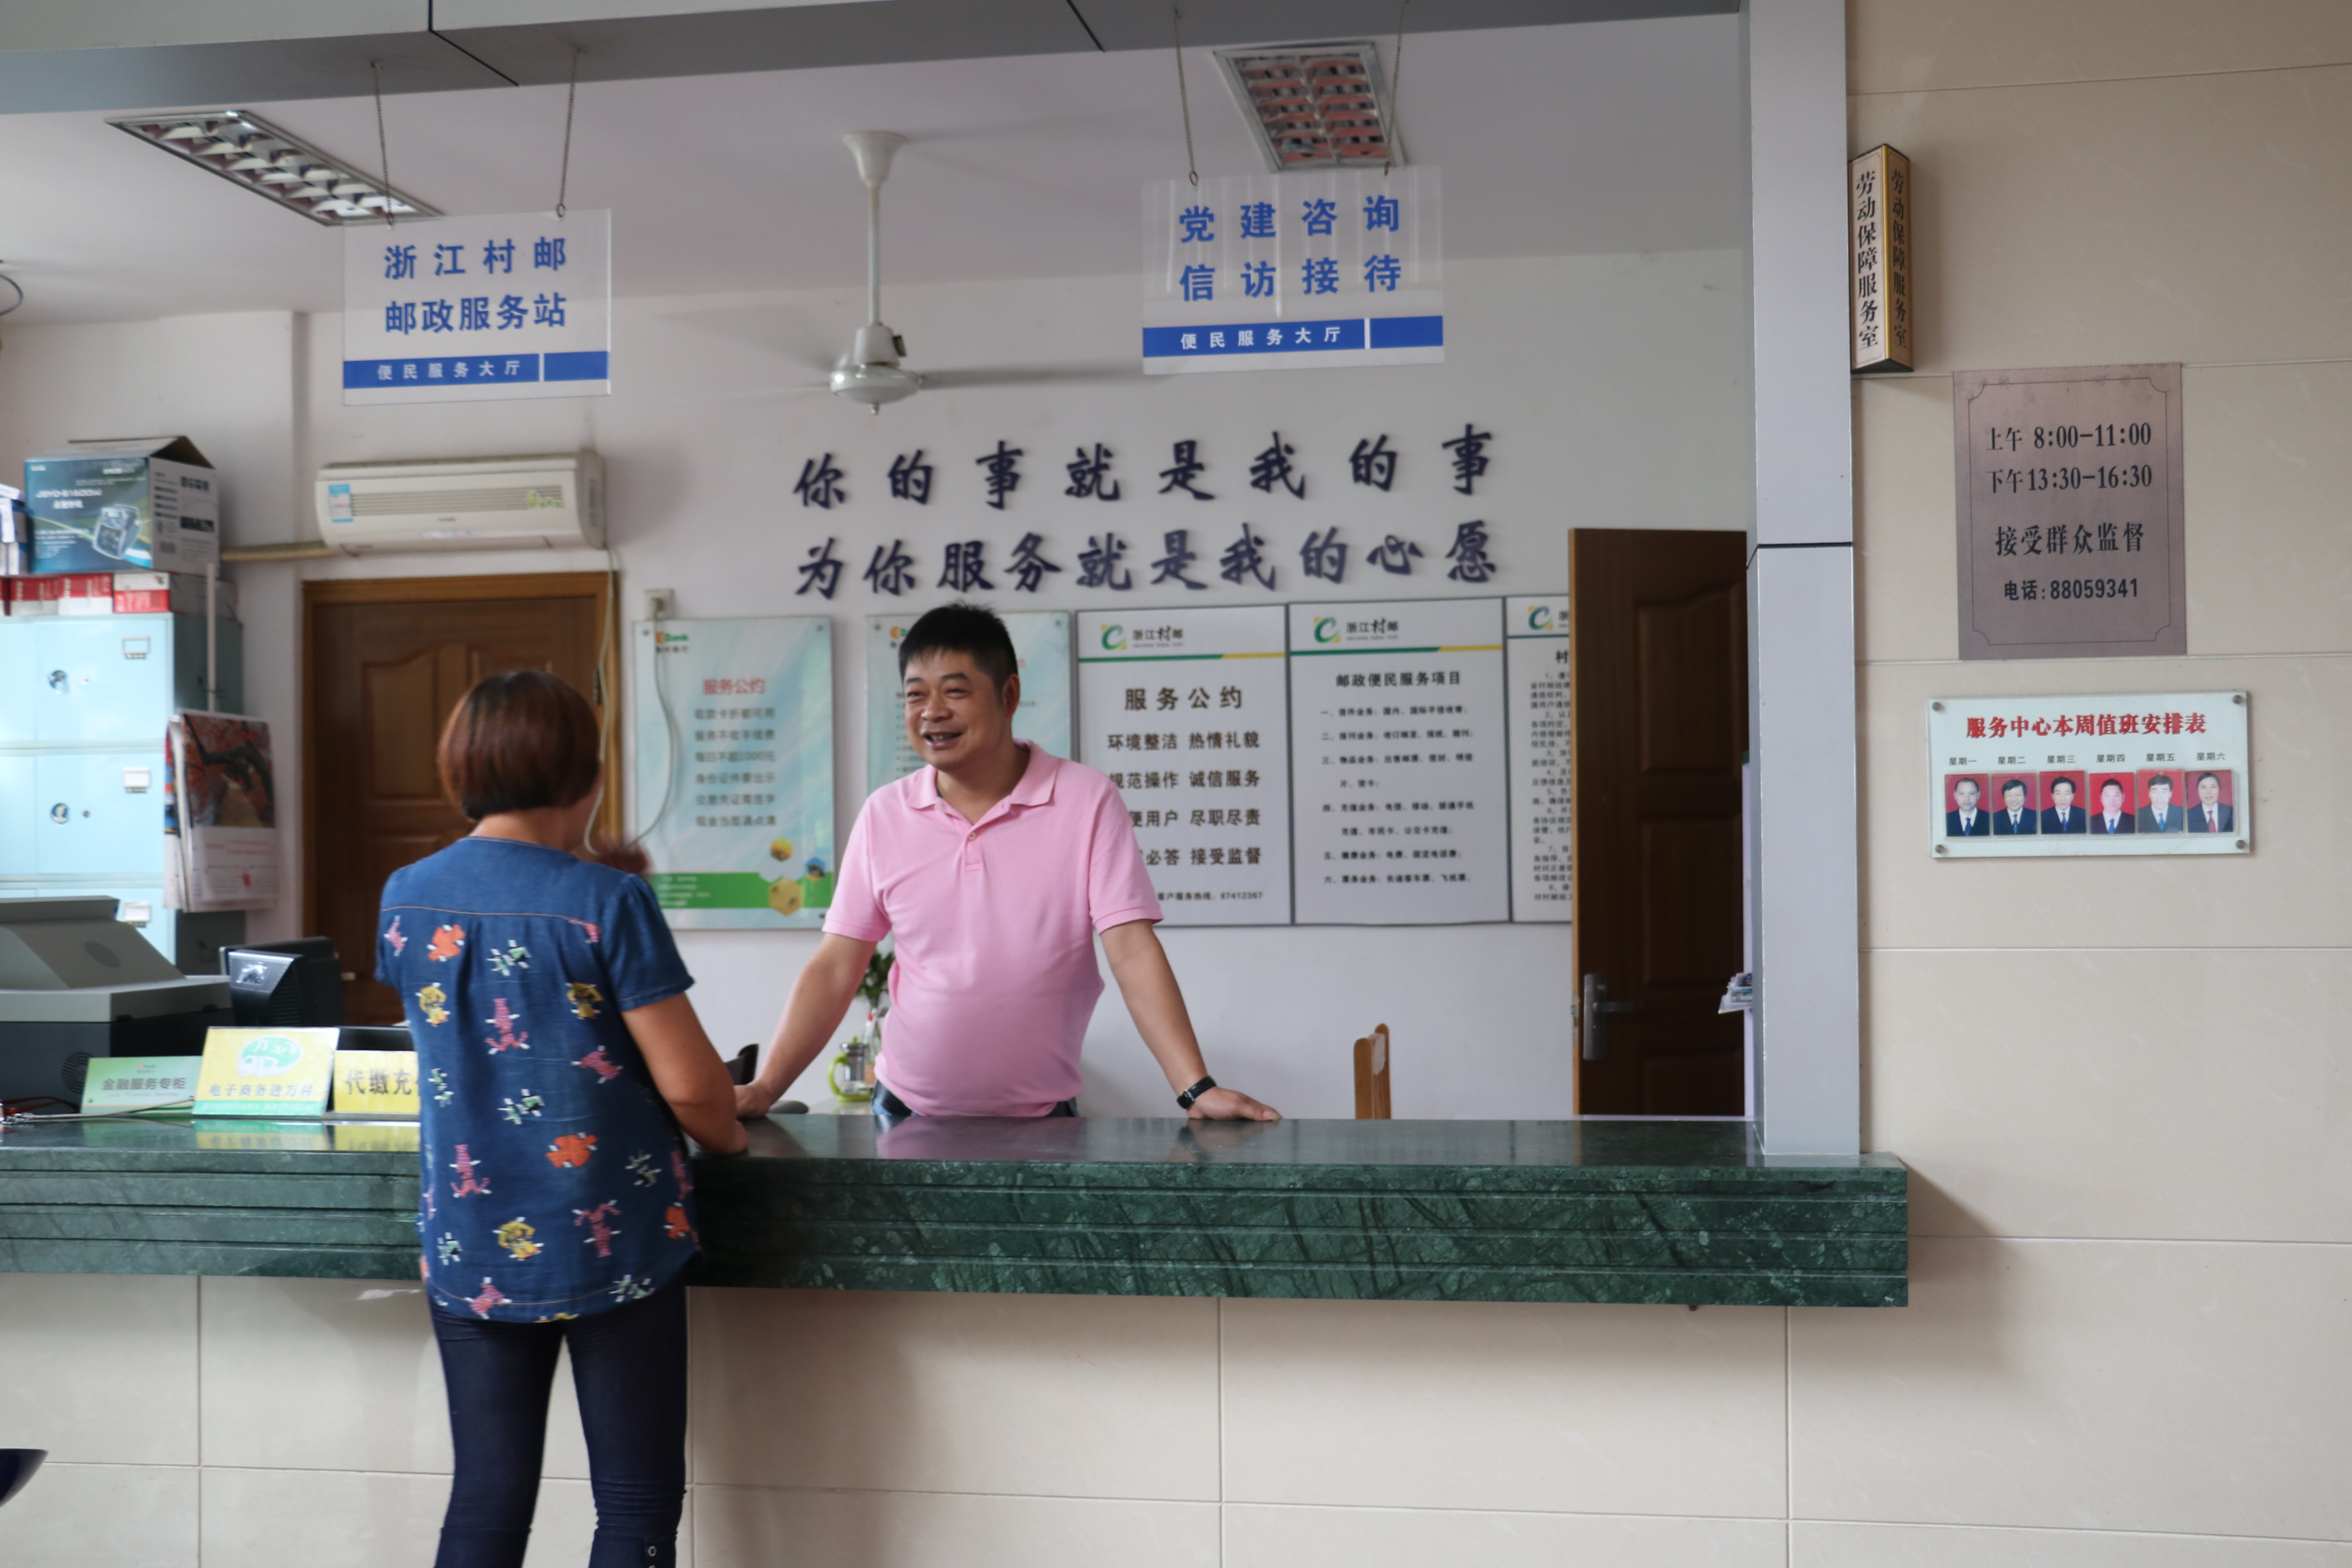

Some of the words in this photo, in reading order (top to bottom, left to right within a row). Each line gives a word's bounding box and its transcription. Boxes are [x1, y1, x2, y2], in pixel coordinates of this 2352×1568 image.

[1179, 195, 1400, 243] 党建咨询
[384, 236, 567, 279] 浙江村邮
[1856, 171, 1878, 350] 劳动保障服务室
[1891, 170, 1906, 348] 劳动保障服务室
[1179, 254, 1401, 302] 信访接待
[385, 292, 567, 334] 邮政服务站
[1181, 326, 1340, 349] 便民服务大厅
[377, 360, 521, 380] 便民服务大厅
[1986, 428, 2022, 452] 上午
[793, 423, 1494, 511] 你的事就是我的事
[1995, 522, 2144, 556] 接受群众监督
[794, 520, 1497, 599] 为你服务就是我的心愿
[1133, 624, 1182, 641] 浙江村邮
[1347, 617, 1397, 634] 浙江村邮
[703, 678, 766, 695] 服务公约
[1336, 672, 1461, 688] 邮政便民服务项目
[1125, 686, 1242, 710] 服务公约
[1966, 712, 2207, 739] 服务中心本周值班安排表
[1107, 733, 1178, 752] 环境整洁
[1189, 731, 1259, 748] 热情礼貌
[1949, 757, 1977, 766] 星期一
[1997, 756, 2026, 765] 星期二
[2047, 755, 2075, 764] 星期三
[2097, 754, 2125, 763] 星期四
[2146, 753, 2175, 762] 星期五
[2196, 752, 2226, 761] 星期六
[1110, 771, 1178, 789] 规范操作
[1189, 769, 1259, 787] 诚信服务
[1190, 808, 1260, 826] 尽职尽责
[1140, 848, 1179, 865] 必答
[1191, 846, 1261, 865] 接受监督
[102, 1077, 187, 1091] 金融服务专柜
[209, 1083, 314, 1097] 电子商务进万村
[346, 1069, 417, 1095] 代缴充
